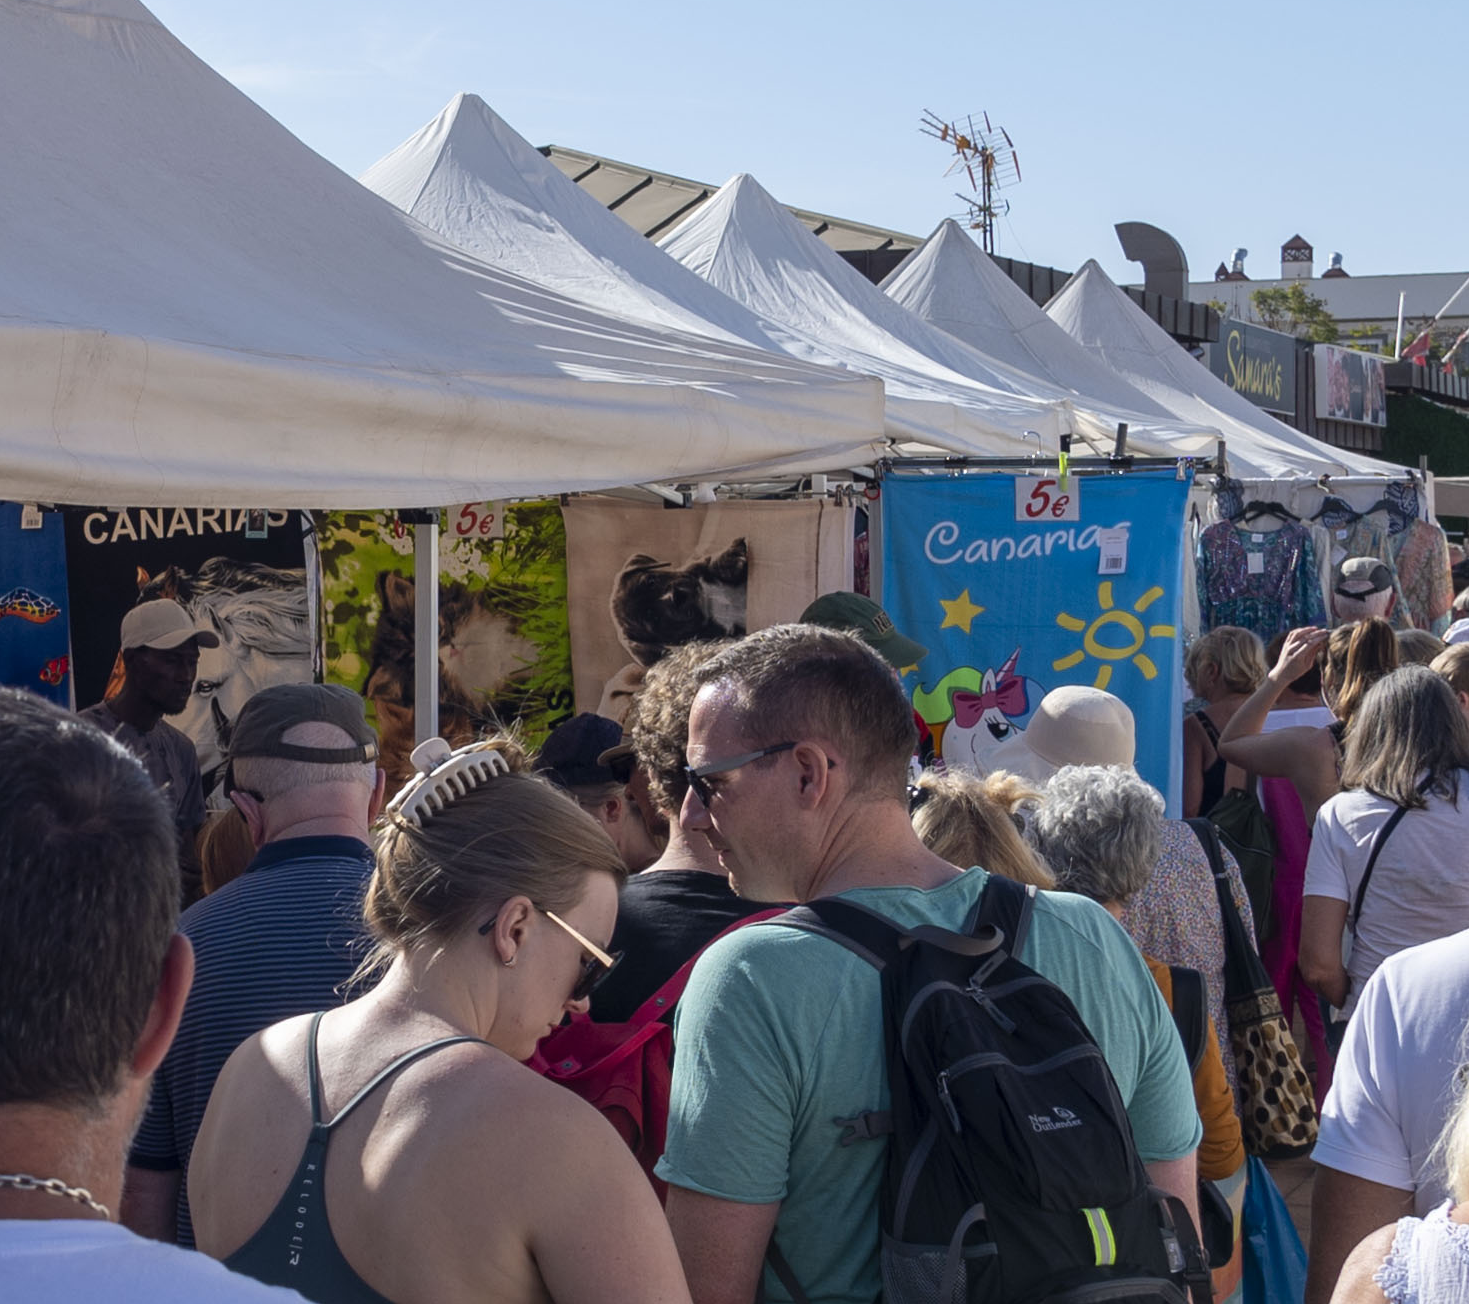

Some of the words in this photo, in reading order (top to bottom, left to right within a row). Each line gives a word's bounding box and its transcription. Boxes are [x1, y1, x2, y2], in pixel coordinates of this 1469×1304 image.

[1225, 329, 1283, 402] Samara's
[456, 501, 495, 536] 5€
[1025, 479, 1070, 519] 5€
